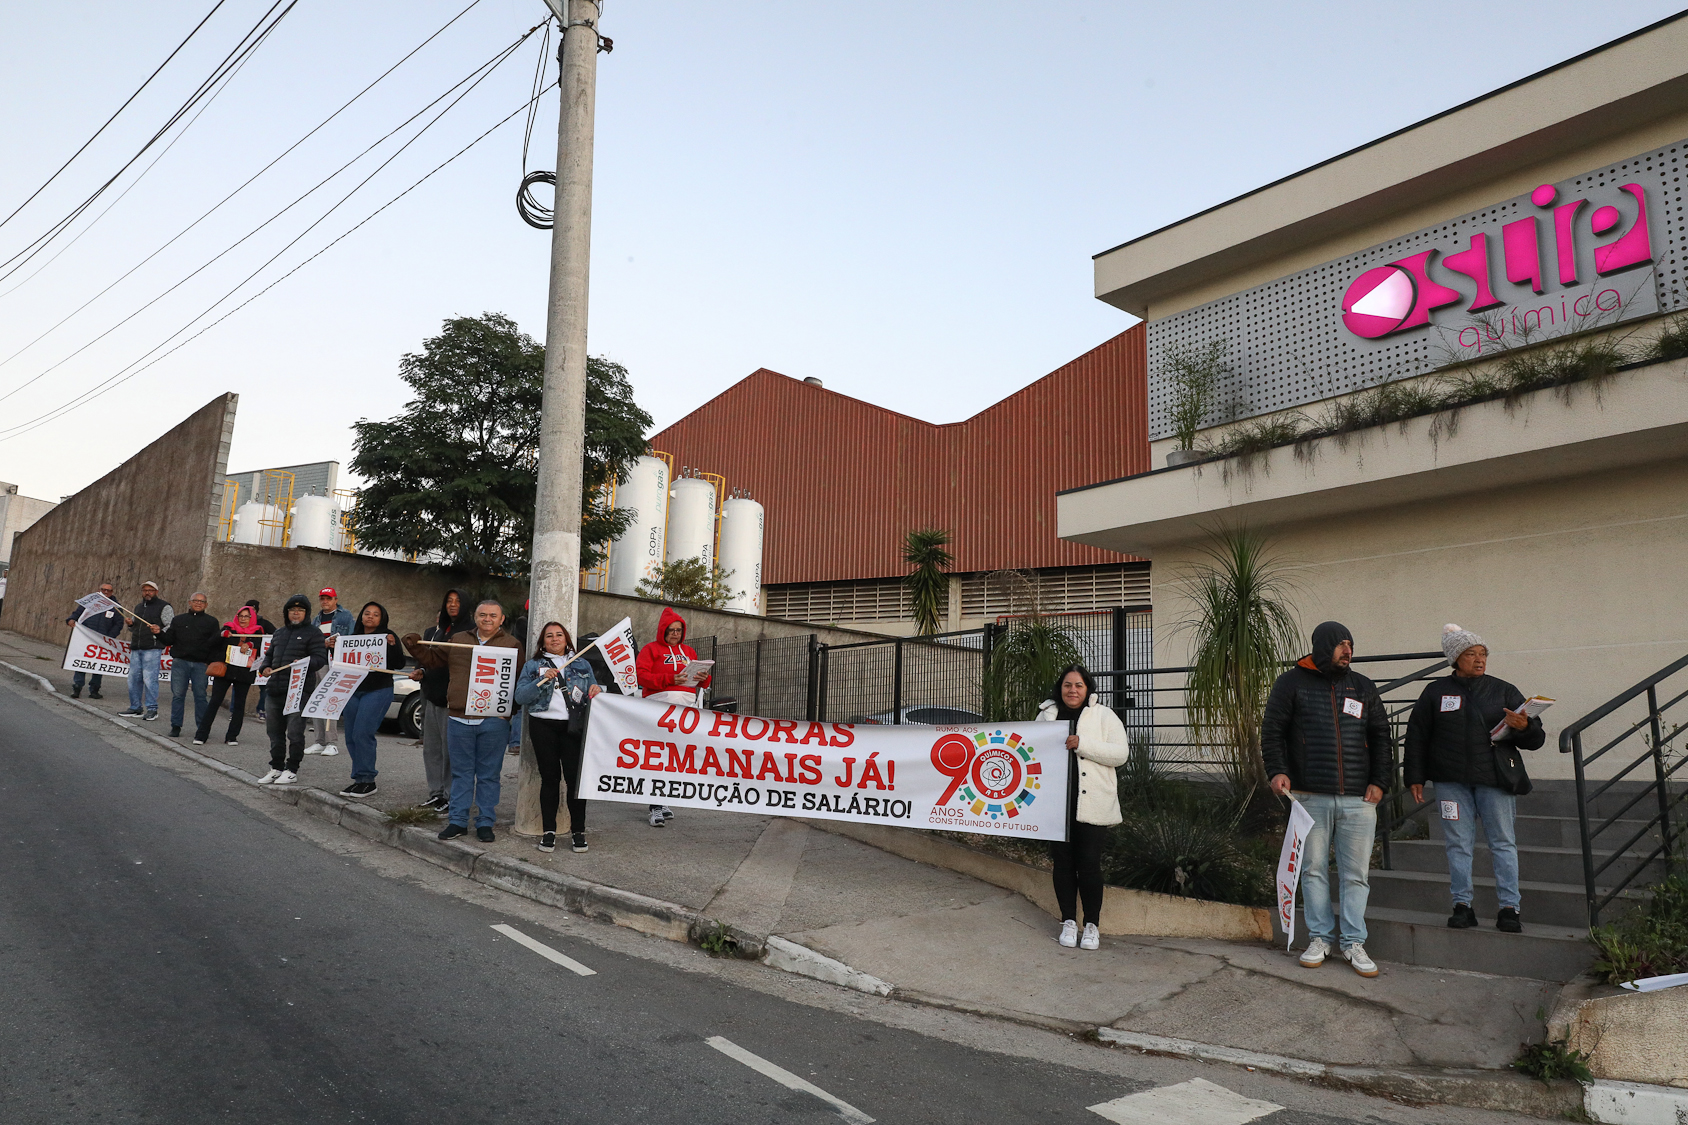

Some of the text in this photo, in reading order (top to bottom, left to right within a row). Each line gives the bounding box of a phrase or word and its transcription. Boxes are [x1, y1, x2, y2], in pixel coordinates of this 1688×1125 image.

[1458, 288, 1622, 353] química
[654, 469, 664, 513] purogas
[328, 508, 337, 547] purogas
[648, 526, 658, 557] COPA
[342, 637, 384, 649] REDUÇÃO
[604, 636, 631, 666] JÁ!
[72, 659, 97, 670] SEM
[475, 655, 499, 685] JÁ!
[496, 657, 512, 714] REDUÇÃO
[657, 704, 855, 748] 40 HORAS
[962, 726, 978, 734] AOS
[616, 738, 895, 791] SEMANAIS JÁ!
[979, 750, 1014, 764] QUÍMICOS
[598, 775, 912, 819] SEM REDUÇÃO DE SALÁRIO!
[930, 806, 964, 818] ANOS
[929, 816, 991, 829] CONSTRUINDO
[1002, 822, 1039, 832] FUTURO
